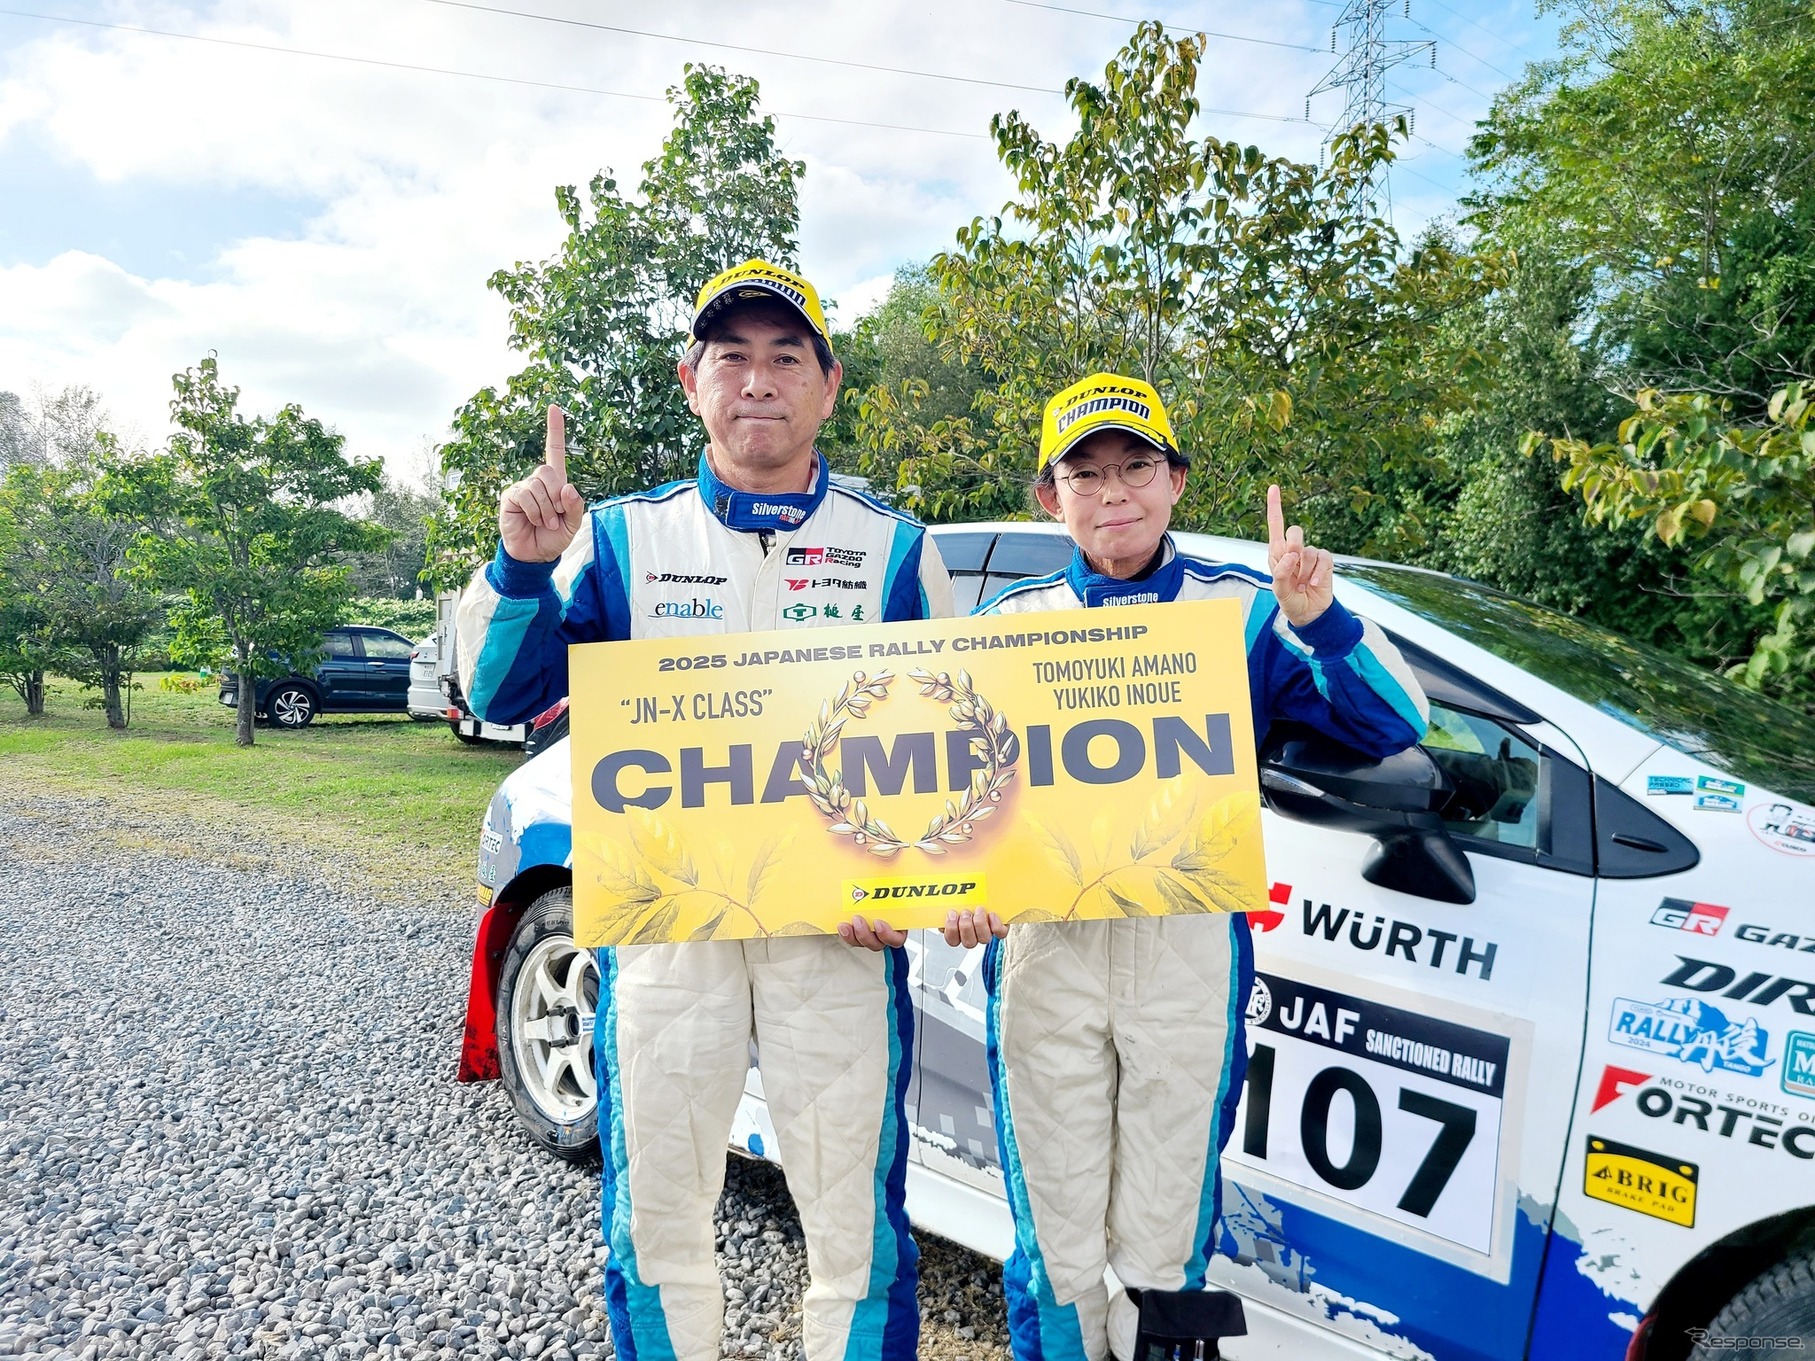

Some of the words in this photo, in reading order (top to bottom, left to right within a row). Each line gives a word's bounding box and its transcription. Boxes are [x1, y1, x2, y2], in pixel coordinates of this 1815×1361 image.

[719, 269, 805, 290] DUNLOP
[1063, 386, 1147, 408] DUNLOP
[1058, 397, 1151, 434] CHAMPION
[751, 502, 806, 519] Silverstone
[787, 554, 823, 566] GR
[825, 553, 863, 562] GAZOO
[826, 547, 867, 556] TOYOTA
[825, 558, 861, 568] Racing
[658, 573, 728, 585] DUNLOP
[811, 578, 867, 590] トヨタ紡織
[655, 598, 723, 618] enable
[1102, 592, 1158, 607] Silverstone
[658, 655, 727, 672] 2025
[733, 645, 863, 667] JAPANESE
[869, 639, 945, 657] RALLY
[952, 625, 1148, 652] CHAMPIONSHIP
[1032, 657, 1126, 684] TOMOYUKI
[1132, 652, 1197, 677] AMANO
[1053, 686, 1120, 710] YUKIKO
[1126, 681, 1182, 706] INOUE
[591, 713, 1235, 814] CHAMPION
[871, 882, 976, 899] DUNLOP
[1651, 907, 1724, 936] GR
[1616, 1011, 1701, 1044] RALLY
[1279, 996, 1361, 1044] JAF
[1366, 1028, 1451, 1074] SANCTIONED
[1451, 1053, 1496, 1087] RALLY
[1628, 1036, 1650, 1047] 2024
[1660, 1076, 1718, 1098] MOTOR
[1725, 1092, 1789, 1116] SPORTS
[1243, 1042, 1478, 1219] 107
[1607, 1187, 1644, 1202] BRAKE
[1652, 1201, 1674, 1212] PAD
